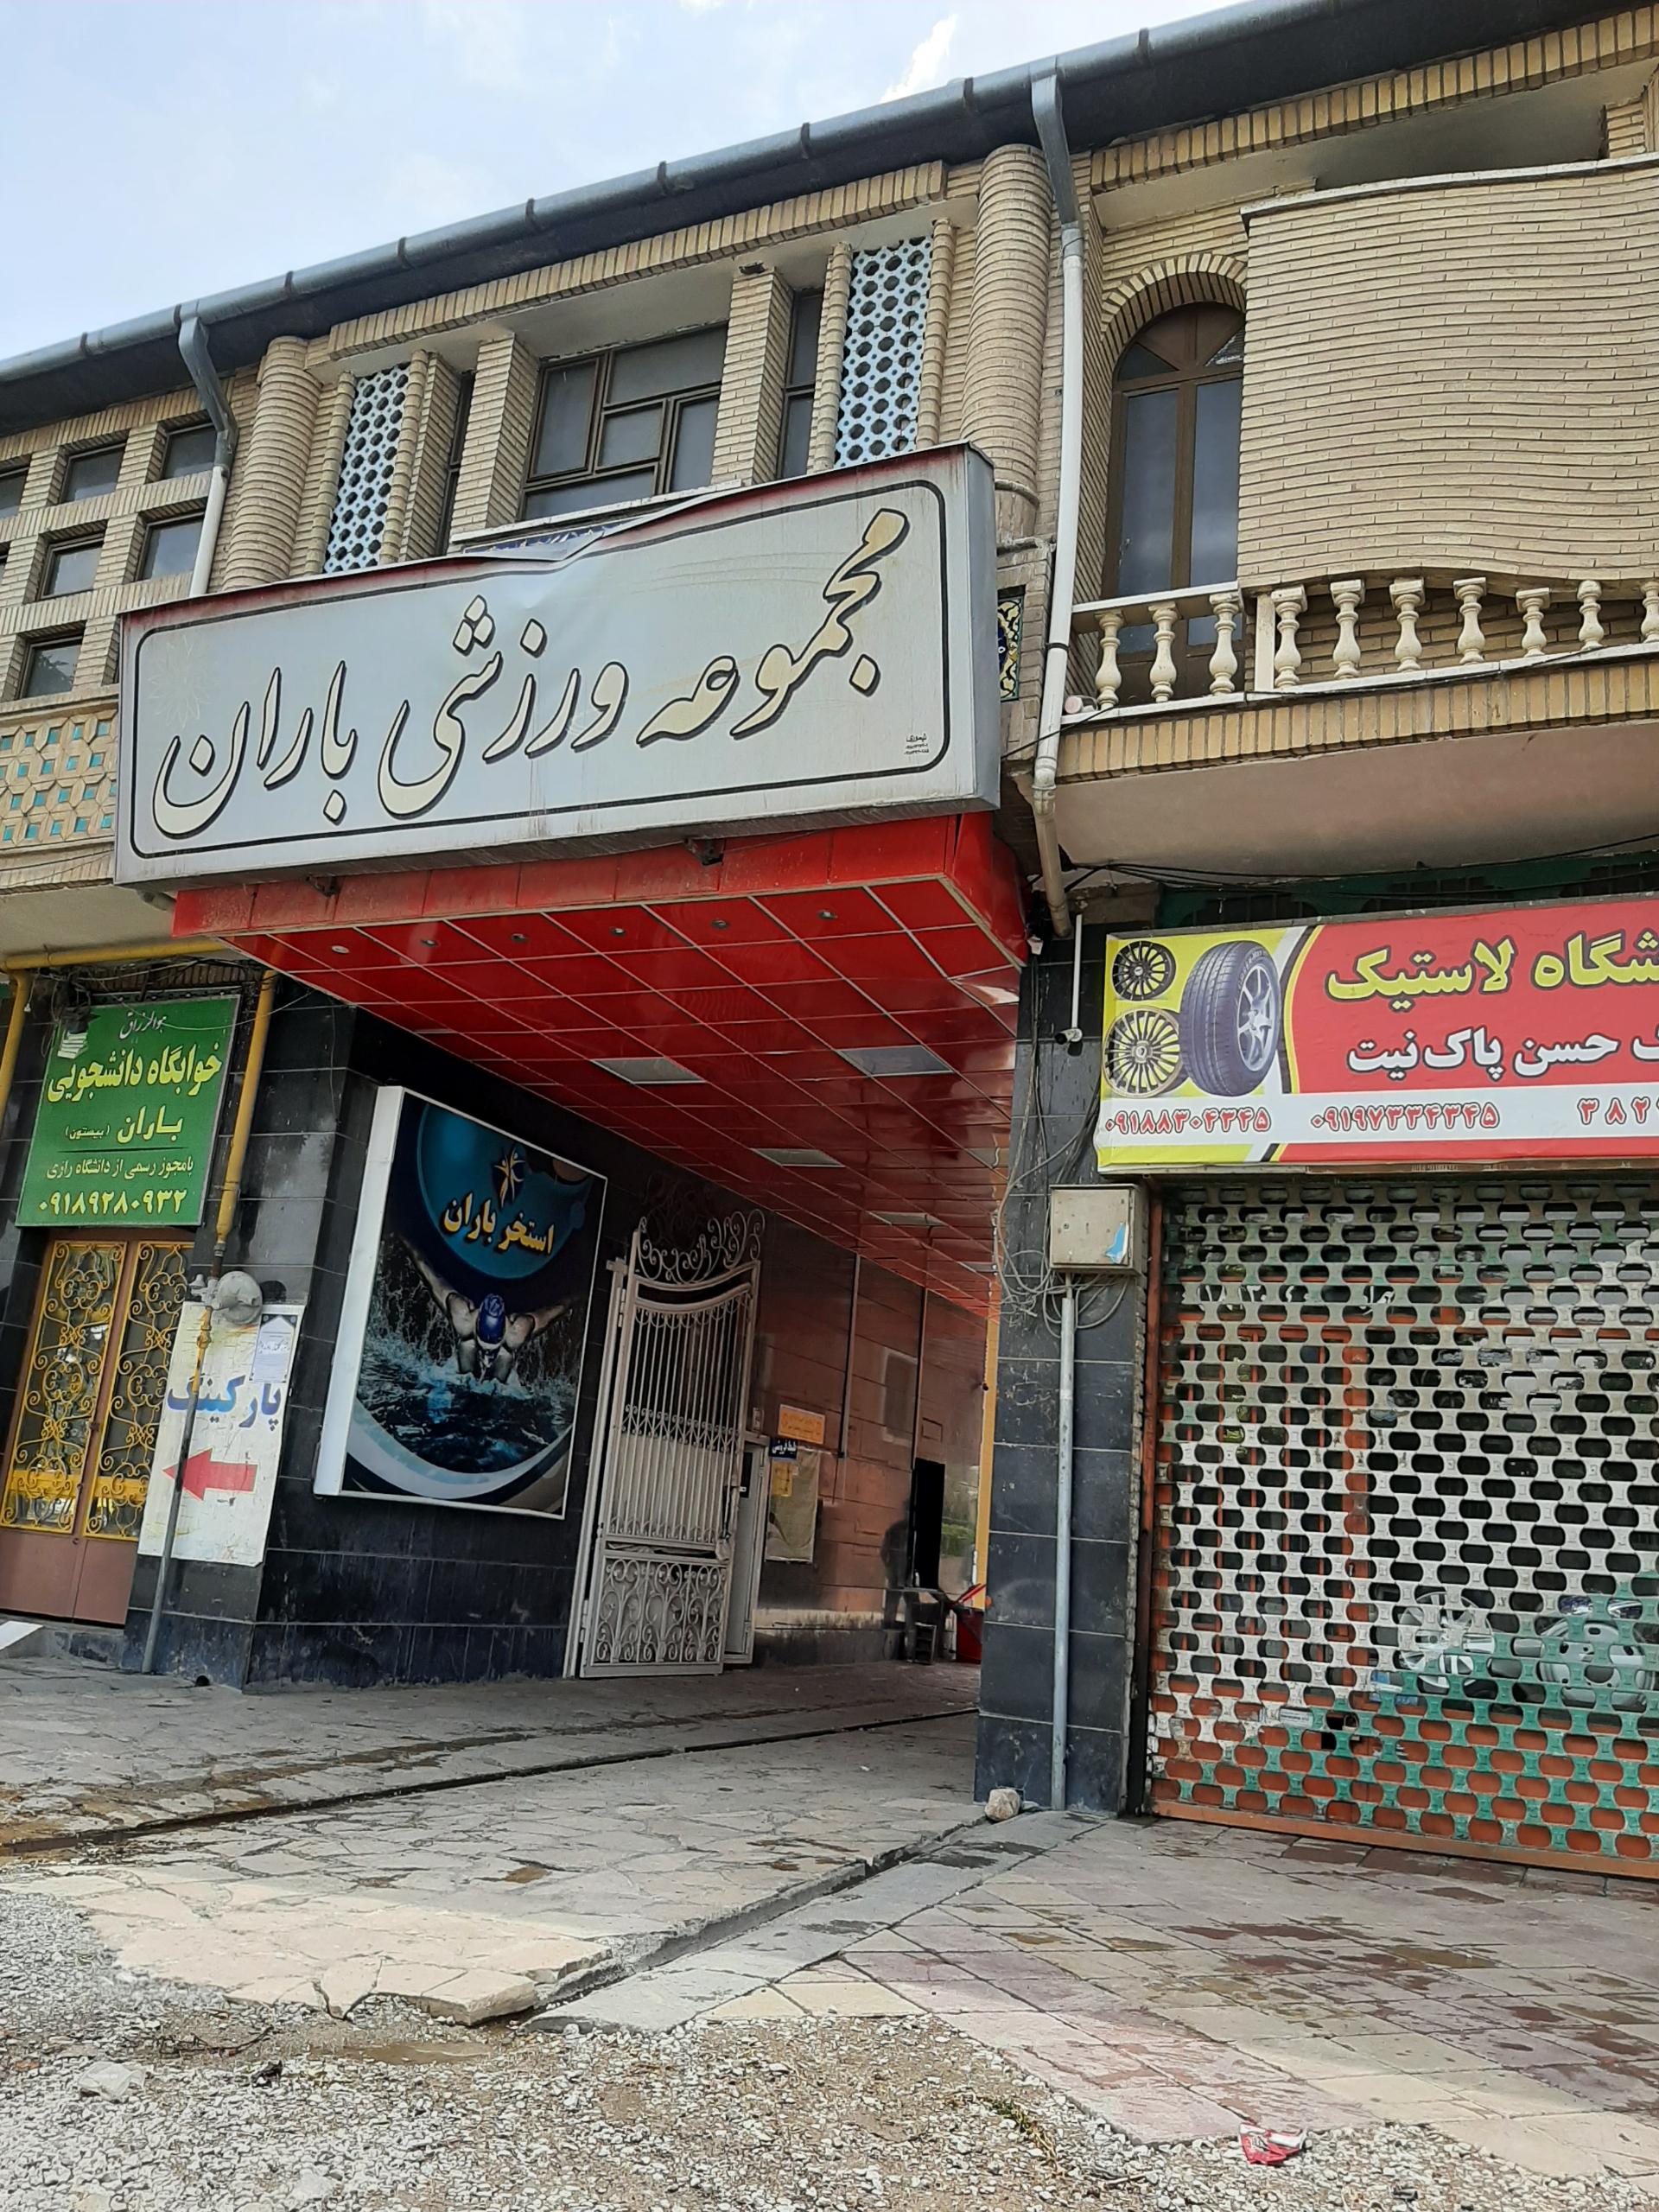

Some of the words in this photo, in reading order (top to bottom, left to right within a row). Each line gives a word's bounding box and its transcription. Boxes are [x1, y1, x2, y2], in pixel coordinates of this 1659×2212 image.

[637, 507, 910, 747] مجموعه
[378, 594, 629, 820] ورزشی
[152, 660, 358, 839] باران
[1325, 936, 1516, 1011] لاستیک
[47, 1046, 143, 1103] دانشجویی
[147, 1041, 223, 1096] خوابگاه
[1512, 1032, 1621, 1077] حسن
[116, 1104, 184, 1144] باران
[1104, 1107, 1272, 1135] ۰۹۱۸۸۳۰۴۳۴۵
[1311, 1102, 1501, 1133] ۰۹۱۹۷۳۳۴۳۴۵
[1577, 1096, 1659, 1126] ۳۸۲
[46, 1160, 73, 1180] رازی
[75, 1157, 111, 1176] دانشگاه
[111, 1158, 124, 1179] از
[124, 1163, 157, 1180] رسمی
[39, 1188, 188, 1216] ۰۹۱۸۹۲۸۰۹۳۲
[442, 1192, 498, 1243] باران
[497, 1211, 556, 1256] استخر
[166, 1372, 283, 1432] پارکینگ
